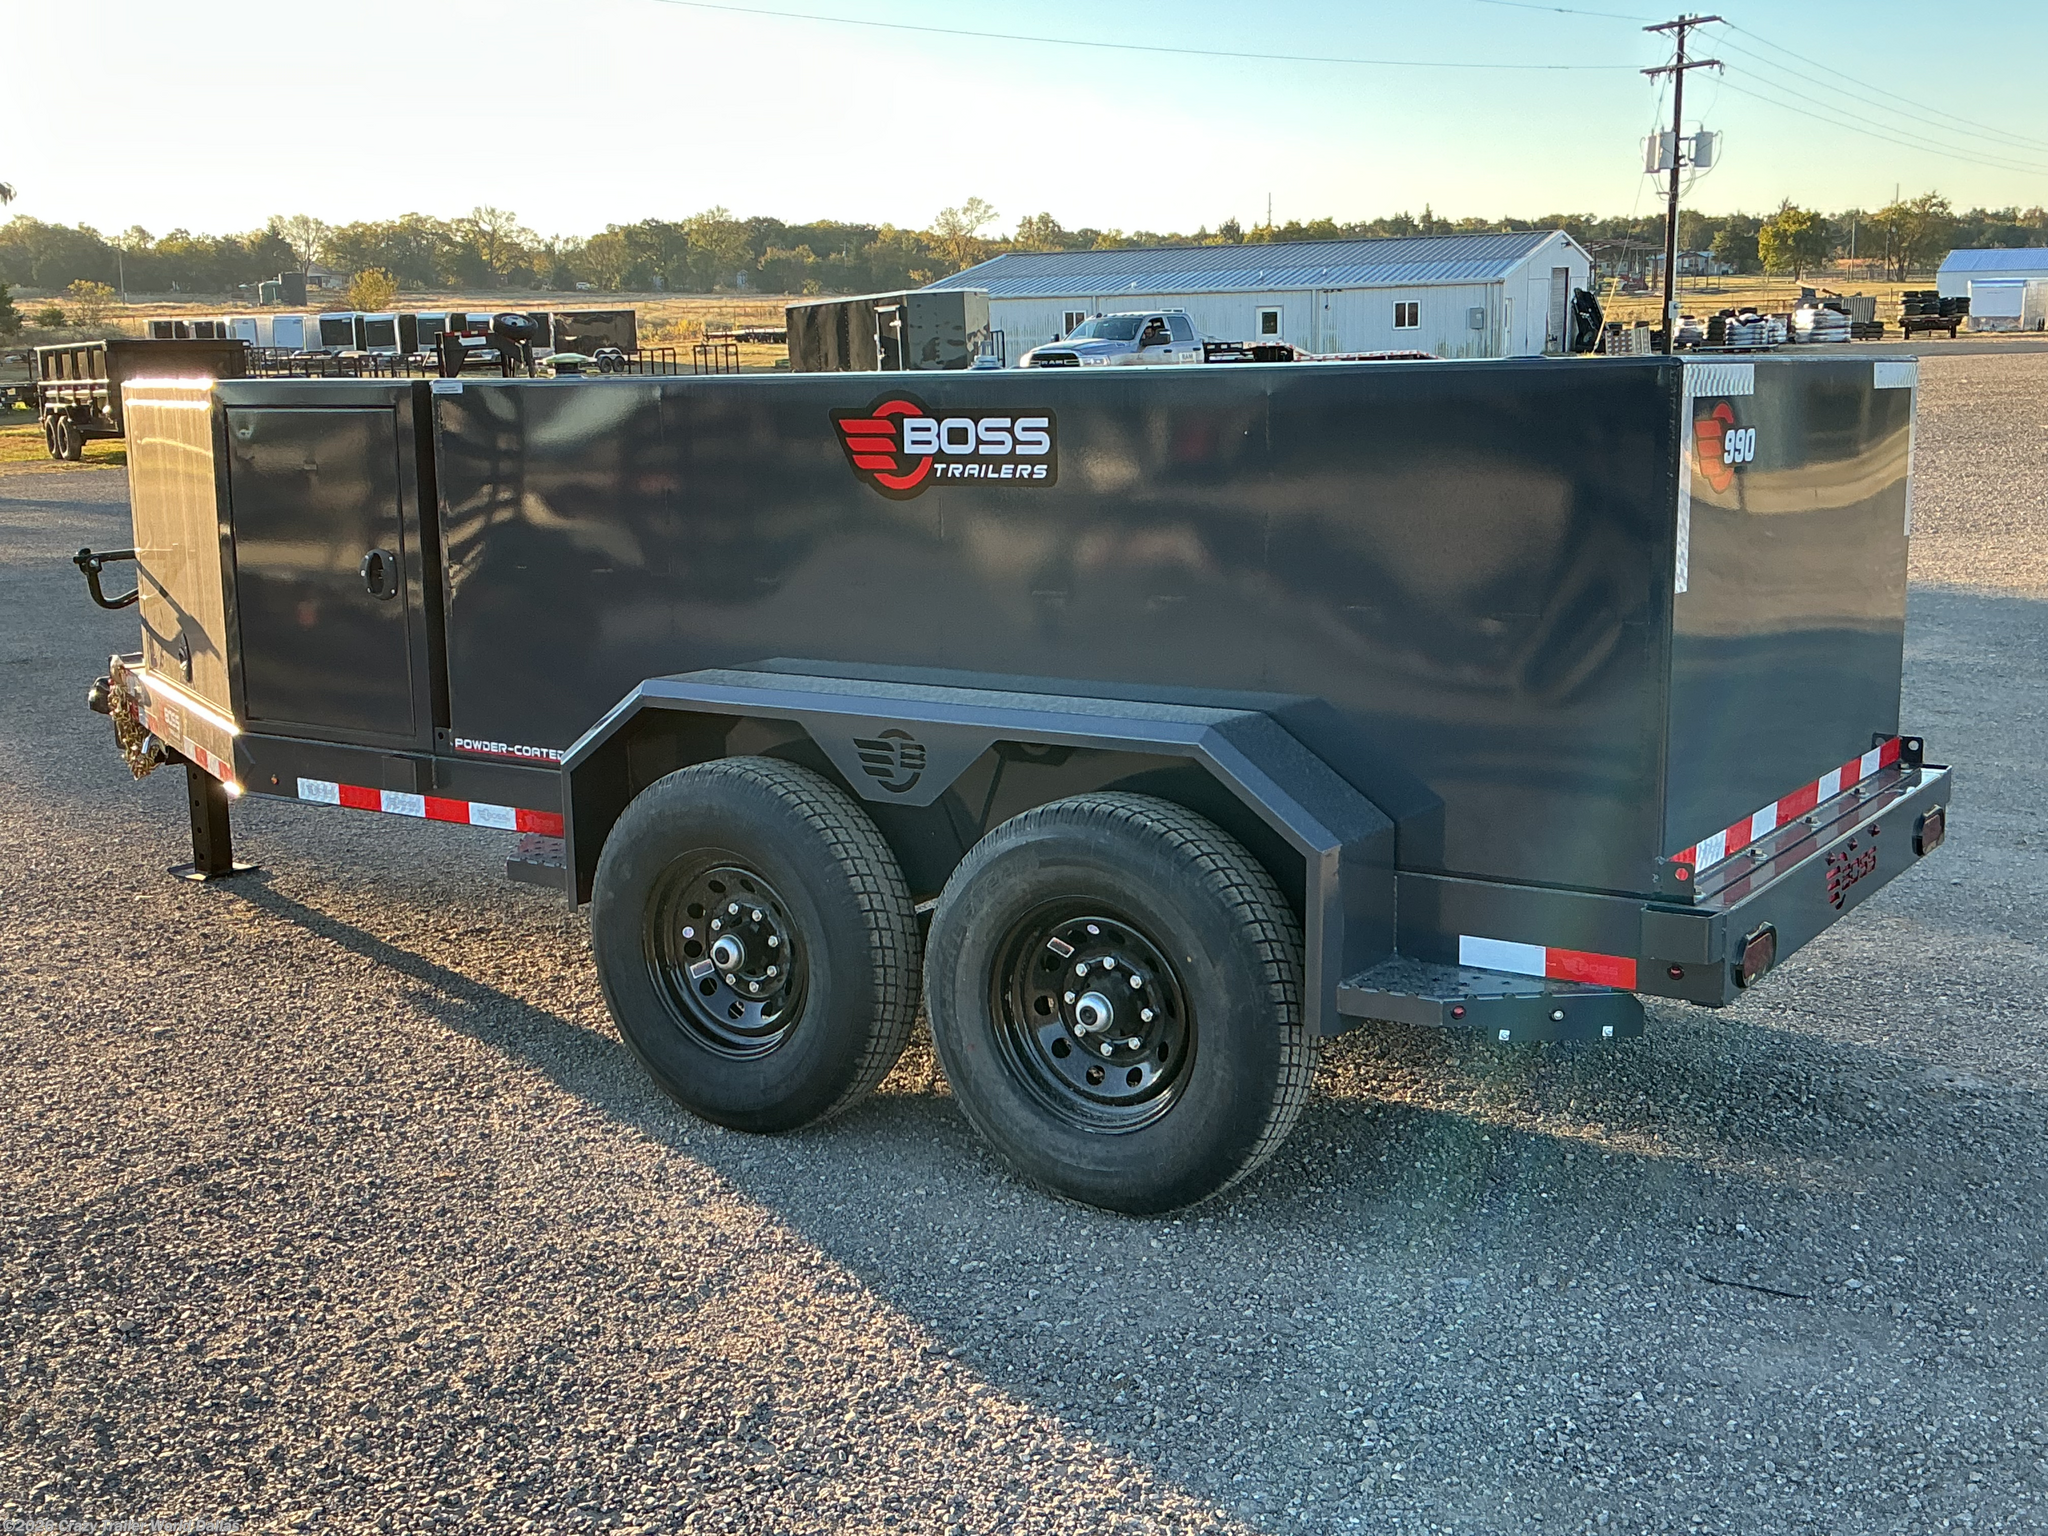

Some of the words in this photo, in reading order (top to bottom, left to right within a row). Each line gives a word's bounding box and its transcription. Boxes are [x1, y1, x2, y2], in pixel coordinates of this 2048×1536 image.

[903, 417, 1051, 456] BOSS
[1723, 427, 1756, 465] 990
[933, 463, 1049, 479] TRAILERS
[1841, 845, 1877, 891] BOSS
